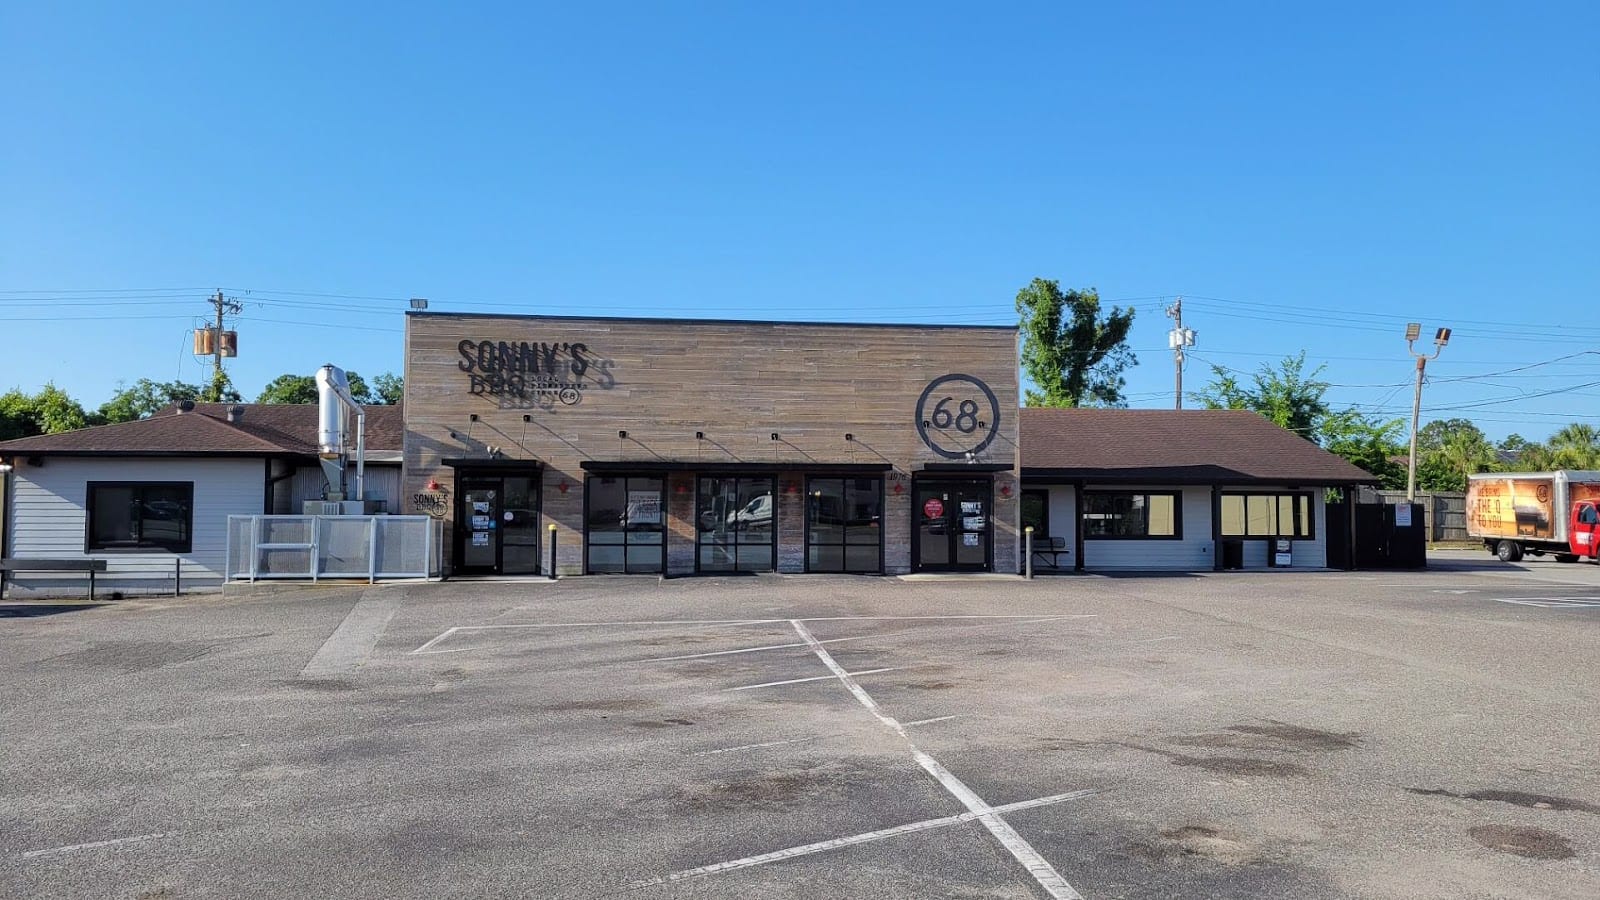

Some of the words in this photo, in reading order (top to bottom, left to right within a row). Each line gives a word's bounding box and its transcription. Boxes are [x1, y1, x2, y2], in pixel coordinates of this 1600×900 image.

[458, 340, 588, 375] SONNY'S
[467, 374, 526, 398] BBQ
[562, 391, 577, 401] 68
[932, 396, 979, 434] 68
[413, 493, 449, 505] SONNY'S
[1478, 498, 1491, 513] THE
[1478, 514, 1487, 528] TO
[1488, 515, 1502, 529] YOU
